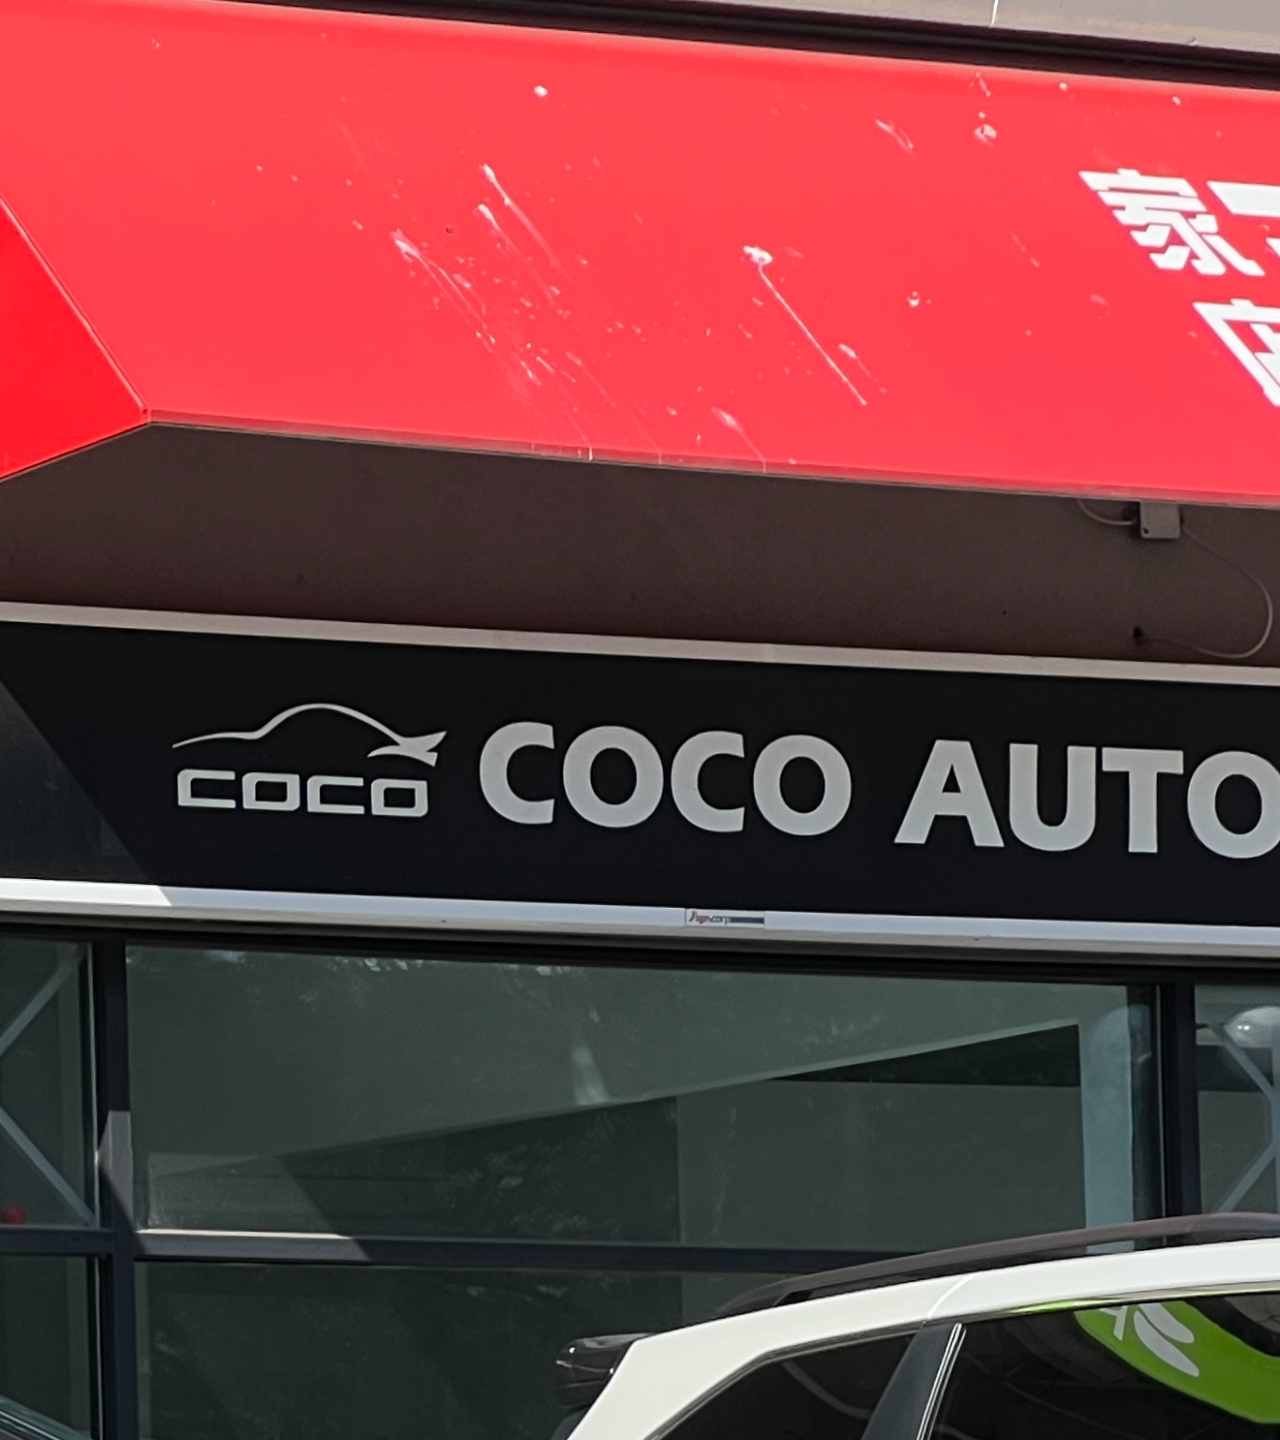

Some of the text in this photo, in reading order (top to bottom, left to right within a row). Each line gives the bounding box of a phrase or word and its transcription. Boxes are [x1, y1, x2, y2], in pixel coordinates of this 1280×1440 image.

[177, 768, 429, 818] COCO
[479, 721, 1280, 859] COCO AUTO
